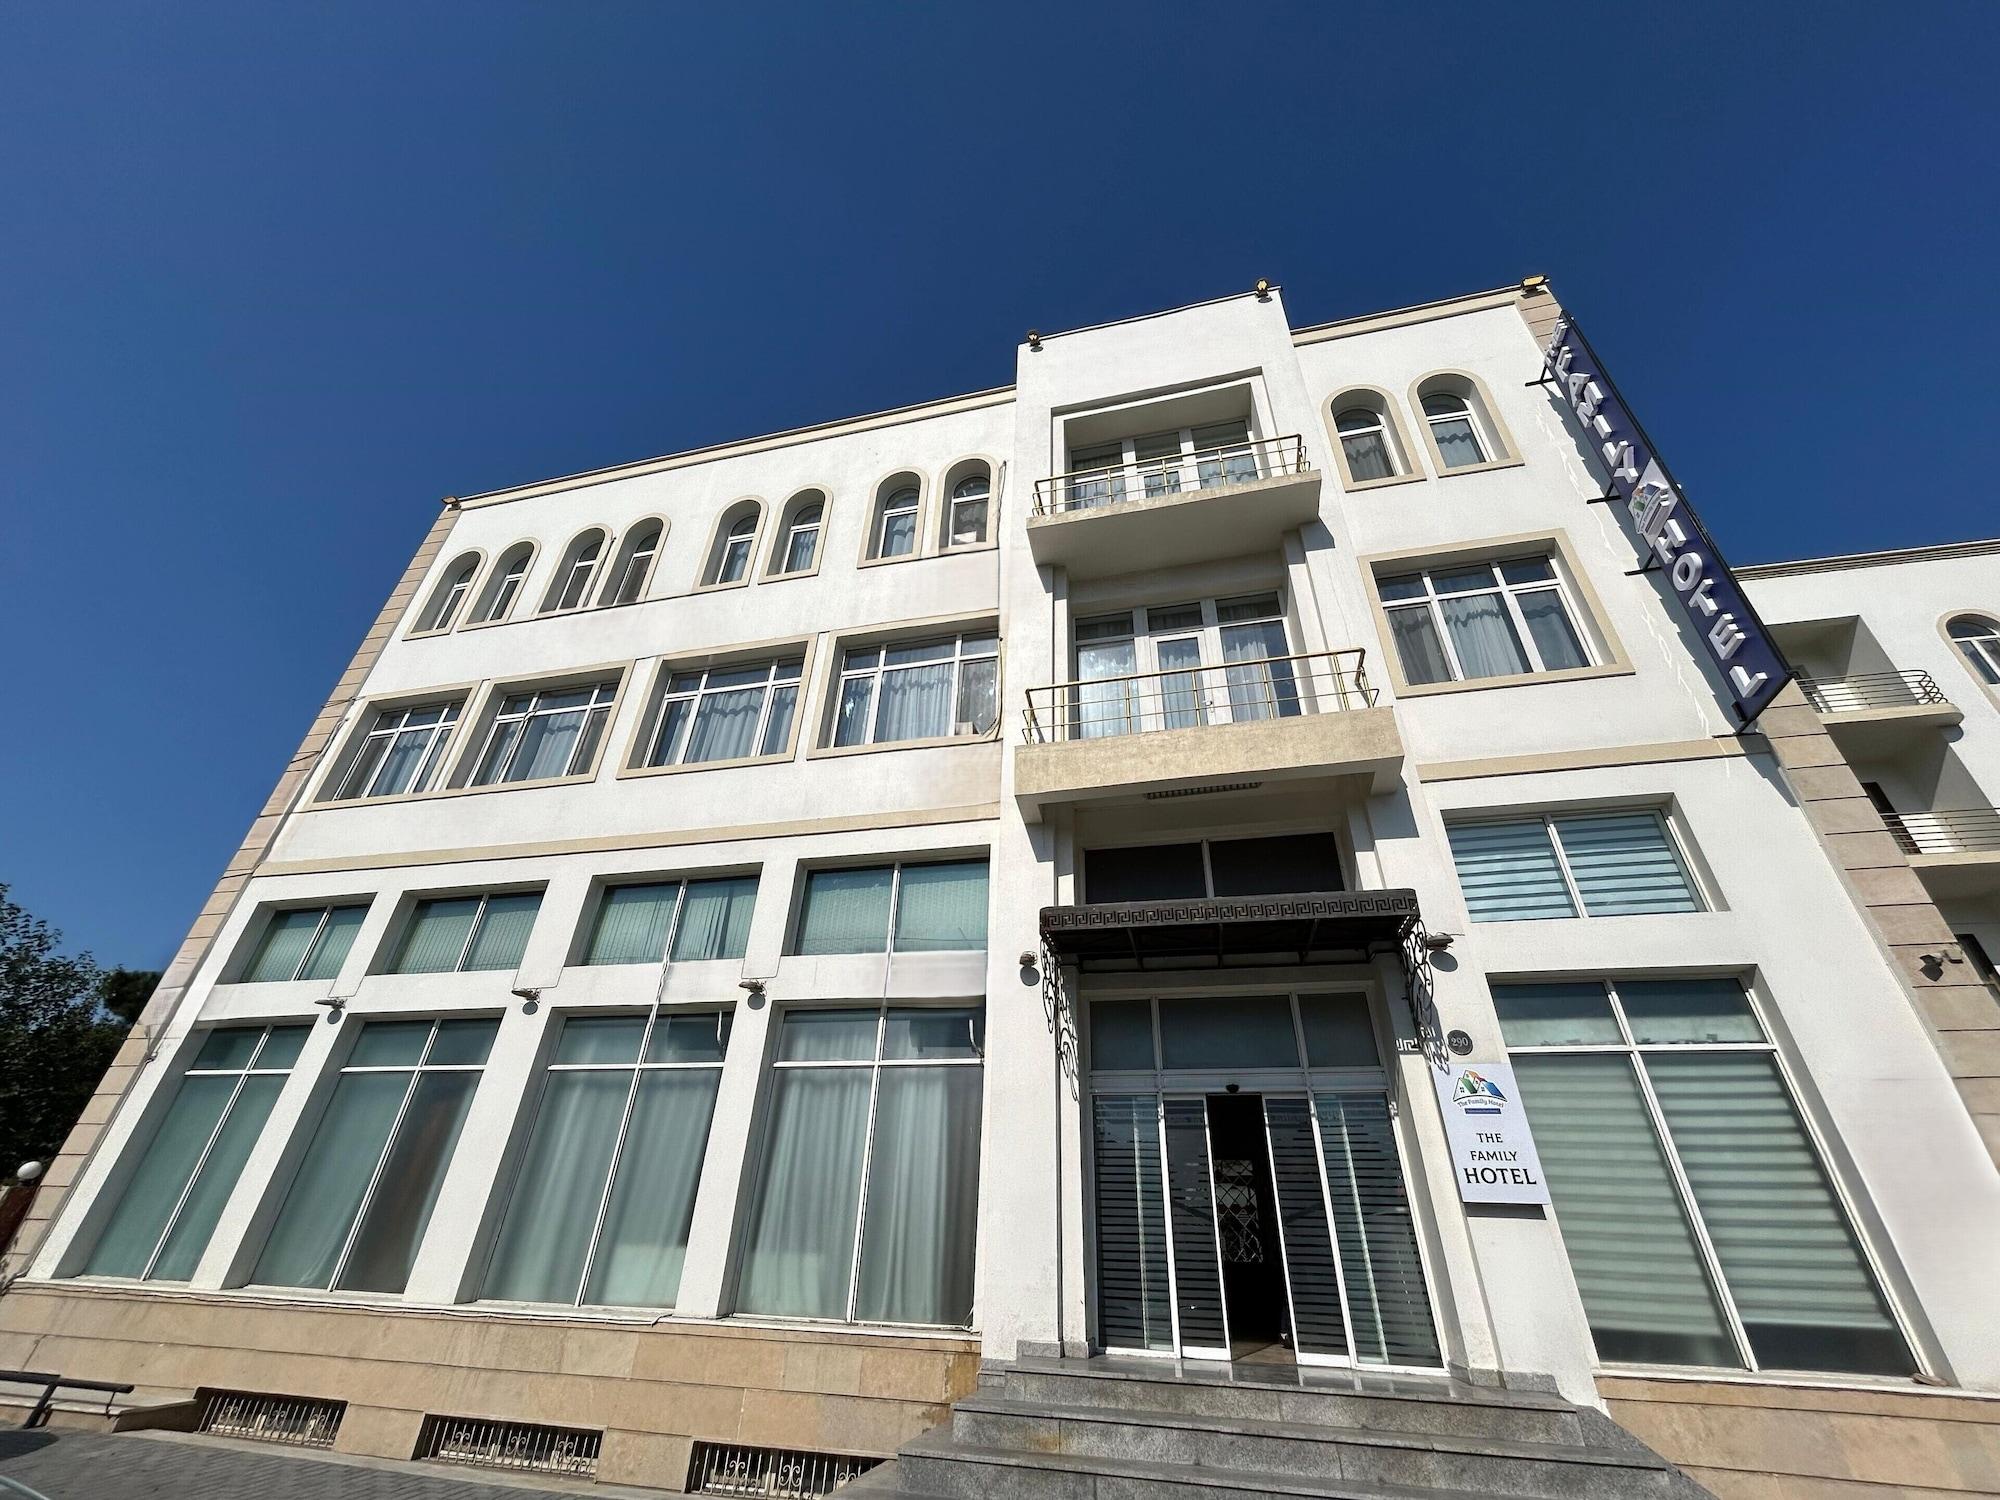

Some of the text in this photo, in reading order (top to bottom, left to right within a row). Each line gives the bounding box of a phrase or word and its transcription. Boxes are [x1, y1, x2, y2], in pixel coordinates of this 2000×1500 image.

[1554, 345, 1639, 484] FAMILY
[1654, 518, 1769, 699] HOTEL
[1451, 1036, 1469, 1047] 290
[1476, 1132, 1503, 1143] THE
[1470, 1150, 1518, 1162] FAMILY
[1463, 1167, 1537, 1185] HOTEL
